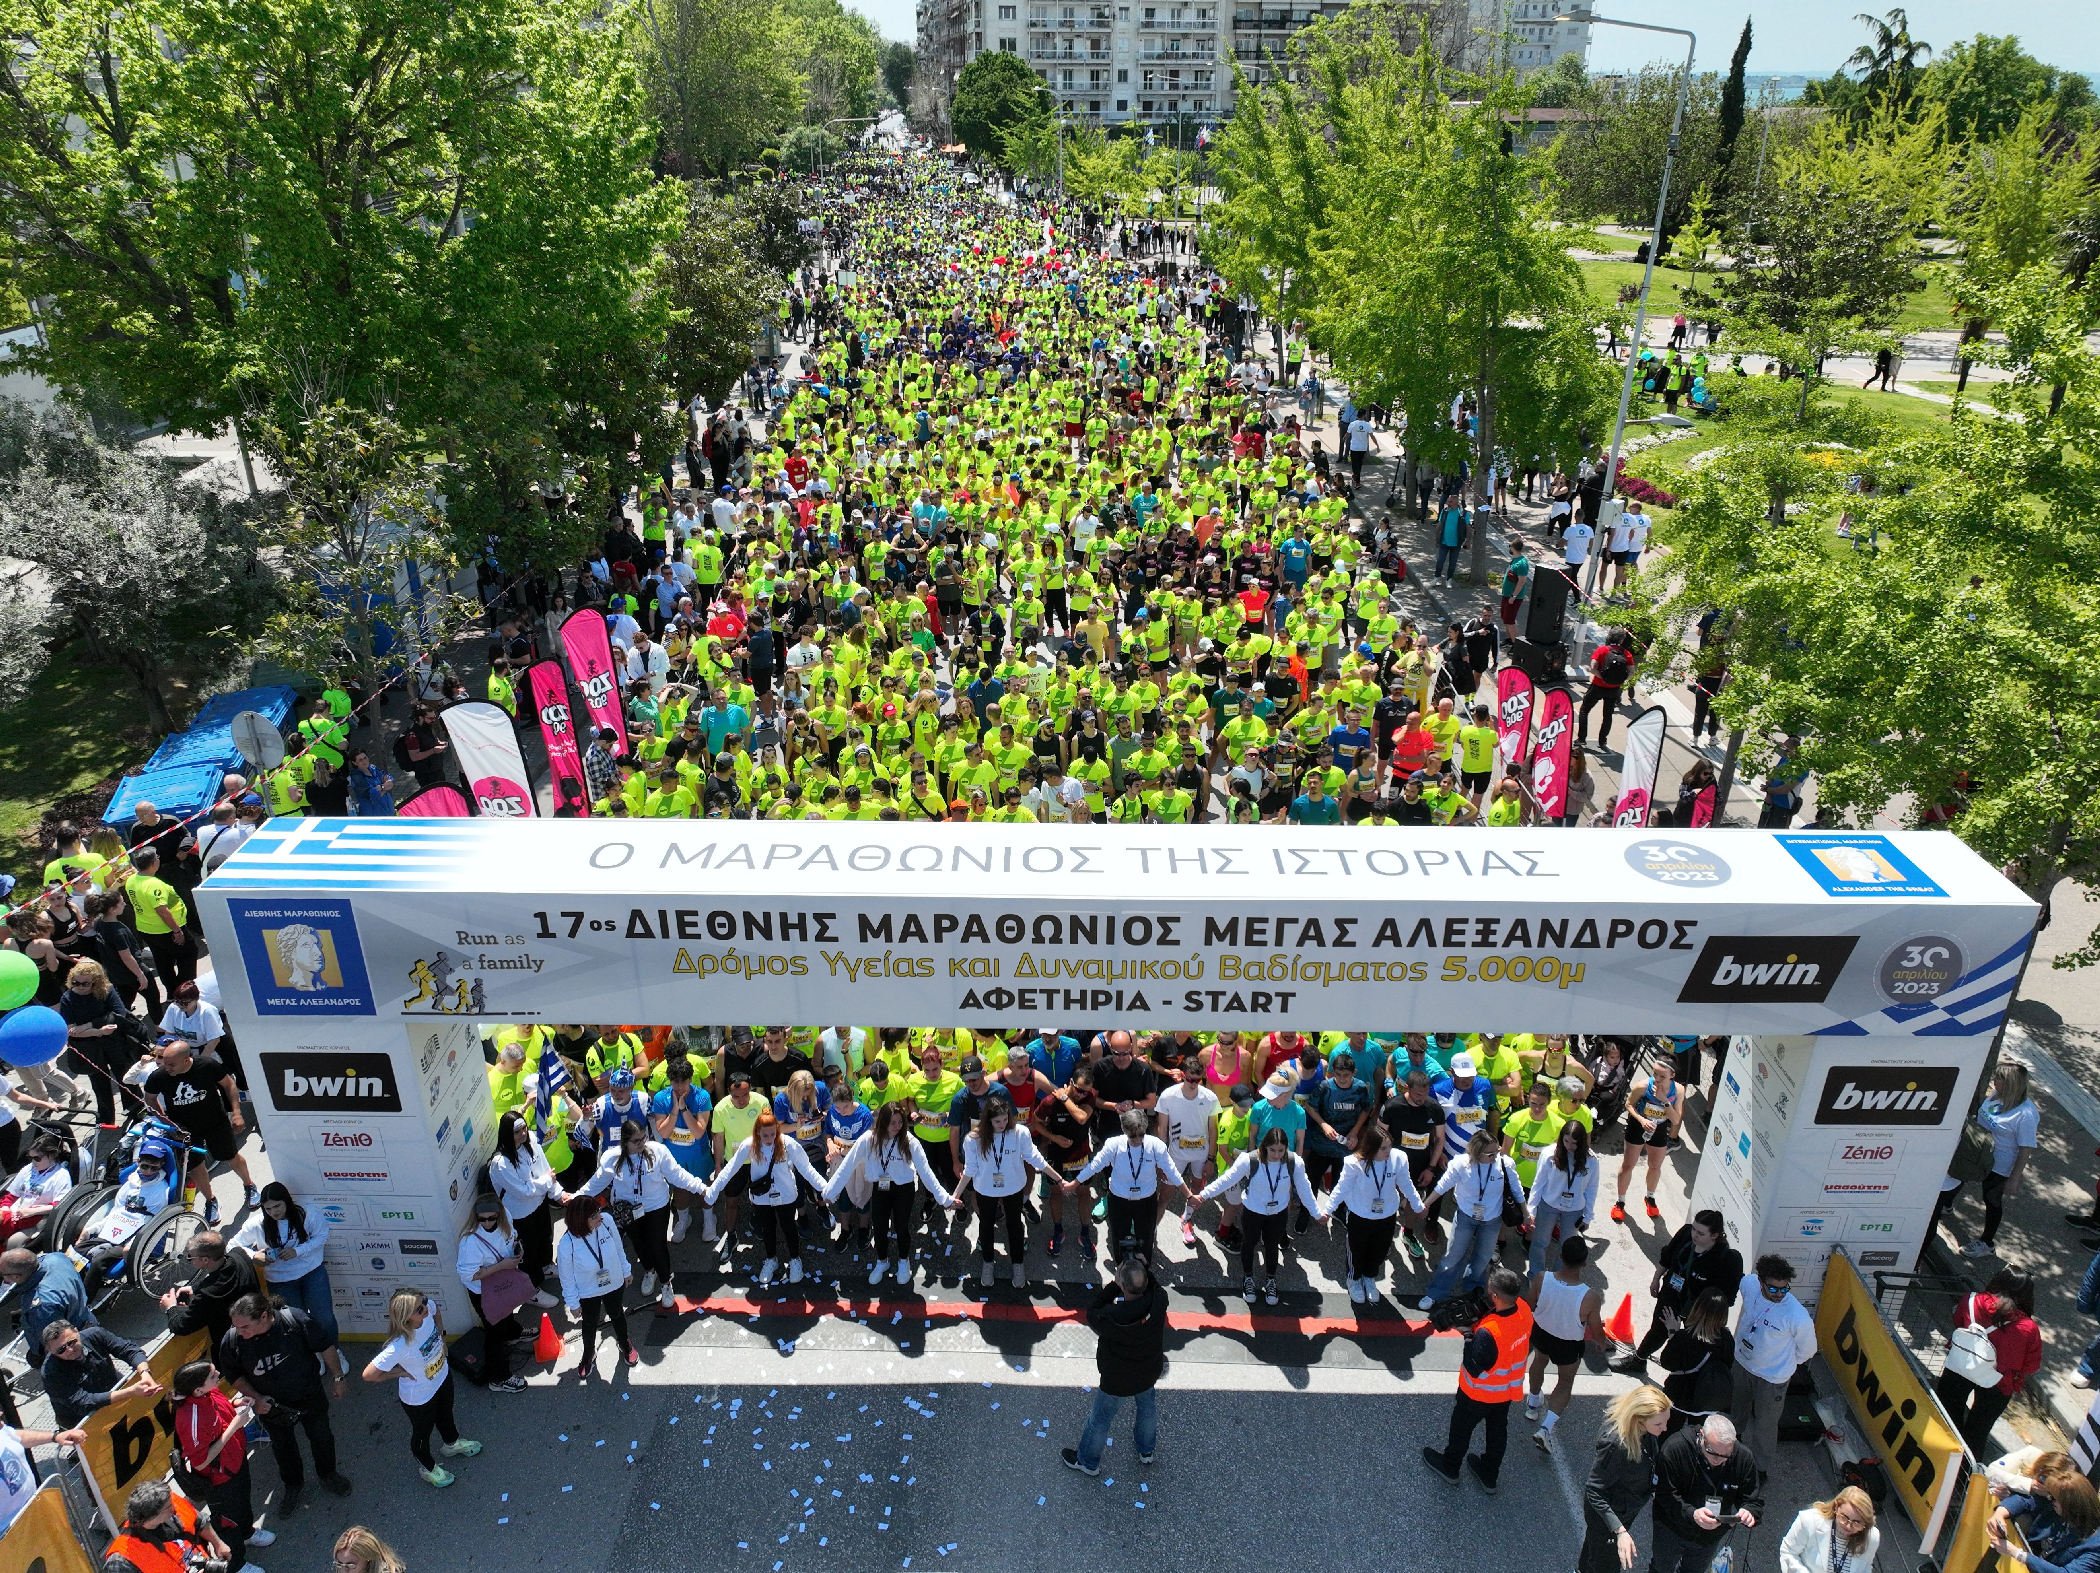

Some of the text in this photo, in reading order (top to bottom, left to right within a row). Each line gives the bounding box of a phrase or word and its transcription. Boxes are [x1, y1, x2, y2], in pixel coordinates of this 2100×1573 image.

[588, 842, 1560, 877] Ο ΜΑΡΑΘΩΝΙΟΣ ΤΗΣ ΙΣΤΟΡΙΑΣ
[1655, 870, 1720, 881] 2023
[244, 910, 342, 918] ΔΙΕΘΝΗΣ ΜΑΡΑΘΩΝΙΟΣ
[456, 929, 526, 947] Run as
[624, 909, 839, 943] ΔΙΕΘΝΗΣ
[858, 912, 1181, 946] ΜΑΡΑΘΩΝΙΟΣ
[1204, 916, 1360, 949] ΜΕΓΑΣ
[1372, 917, 1698, 951] ΑΛΕΞΑΝΔΡΟΣ
[462, 952, 544, 974] a family
[672, 947, 1586, 990] Δρόμος Υγείας και Δυναμικού Βαδίσματος 5.000μ
[1711, 953, 1822, 987] bwin
[1900, 945, 1950, 968] 30
[959, 987, 1152, 1013] ΑΦΕΤΗΡΙΑ
[1183, 990, 1297, 1014] START
[1892, 981, 1940, 995] 2023
[266, 998, 362, 1006] ΜΕΓΑΣ ΑΛΕΞΑΝΔΡΟΣ
[284, 1067, 384, 1098] bwin
[1831, 1081, 1939, 1111] bwin
[1834, 1303, 1936, 1497] bwin
